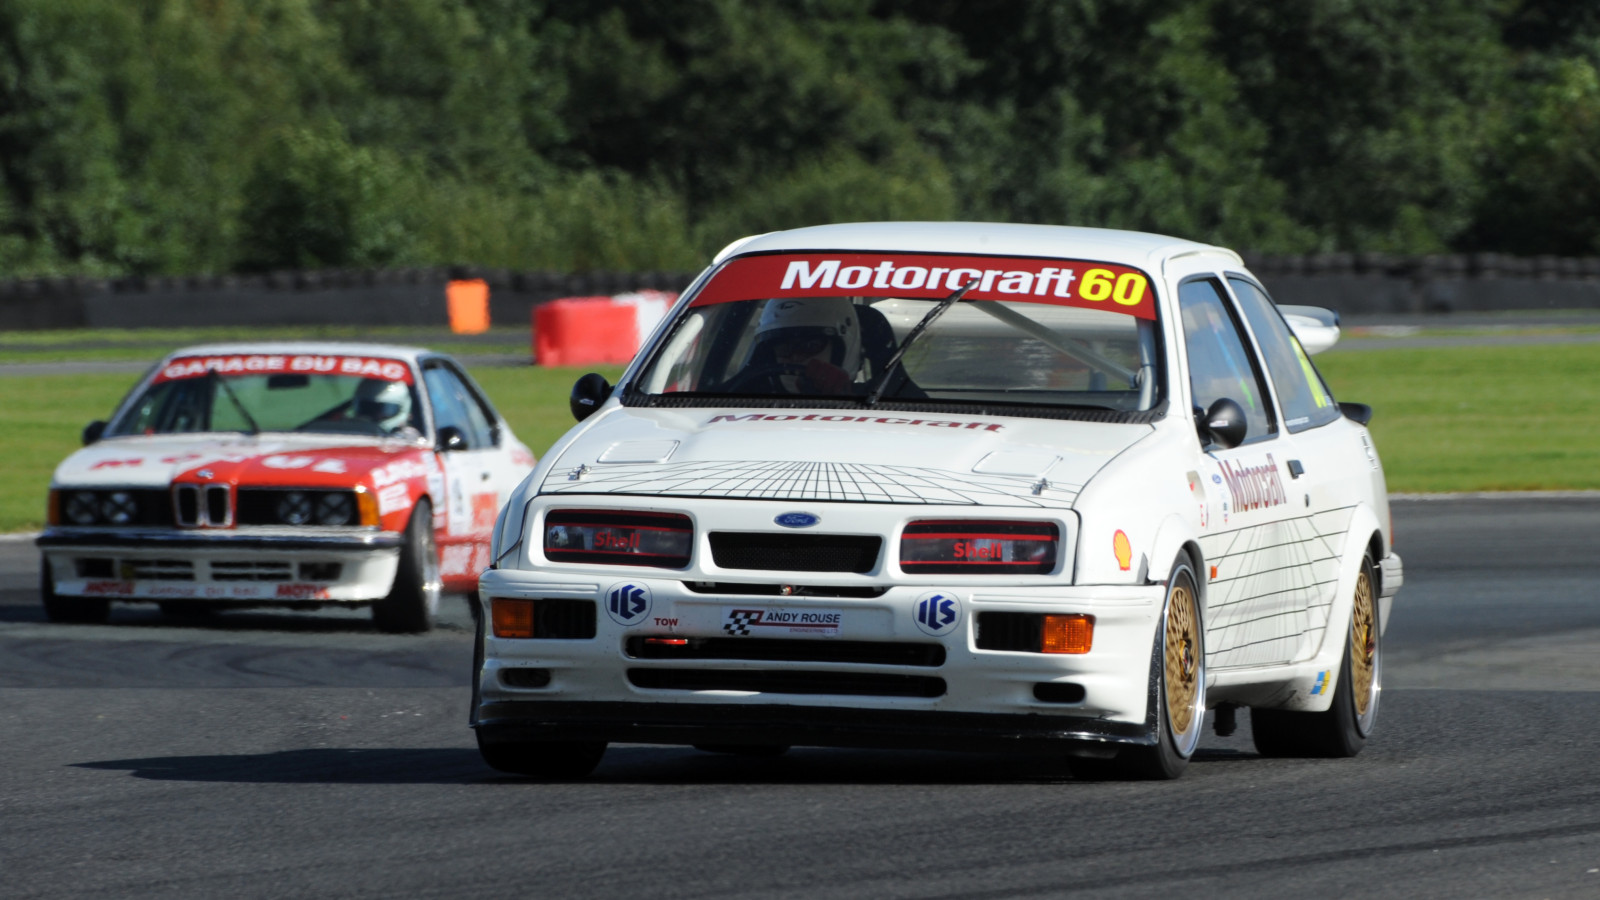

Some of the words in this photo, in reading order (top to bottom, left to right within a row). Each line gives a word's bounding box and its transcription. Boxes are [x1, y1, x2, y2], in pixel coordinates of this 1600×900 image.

[779, 260, 1076, 298] Motorcraft
[1078, 268, 1148, 306] 60
[164, 356, 285, 378] GARAGE
[707, 413, 1005, 433] Motorcraft
[1217, 452, 1287, 514] Motorcraft
[594, 531, 641, 548] Shell
[952, 542, 1003, 559] Shell
[653, 617, 679, 627] TOW
[765, 612, 799, 623] ANDY
[800, 613, 841, 624] ROUSE
